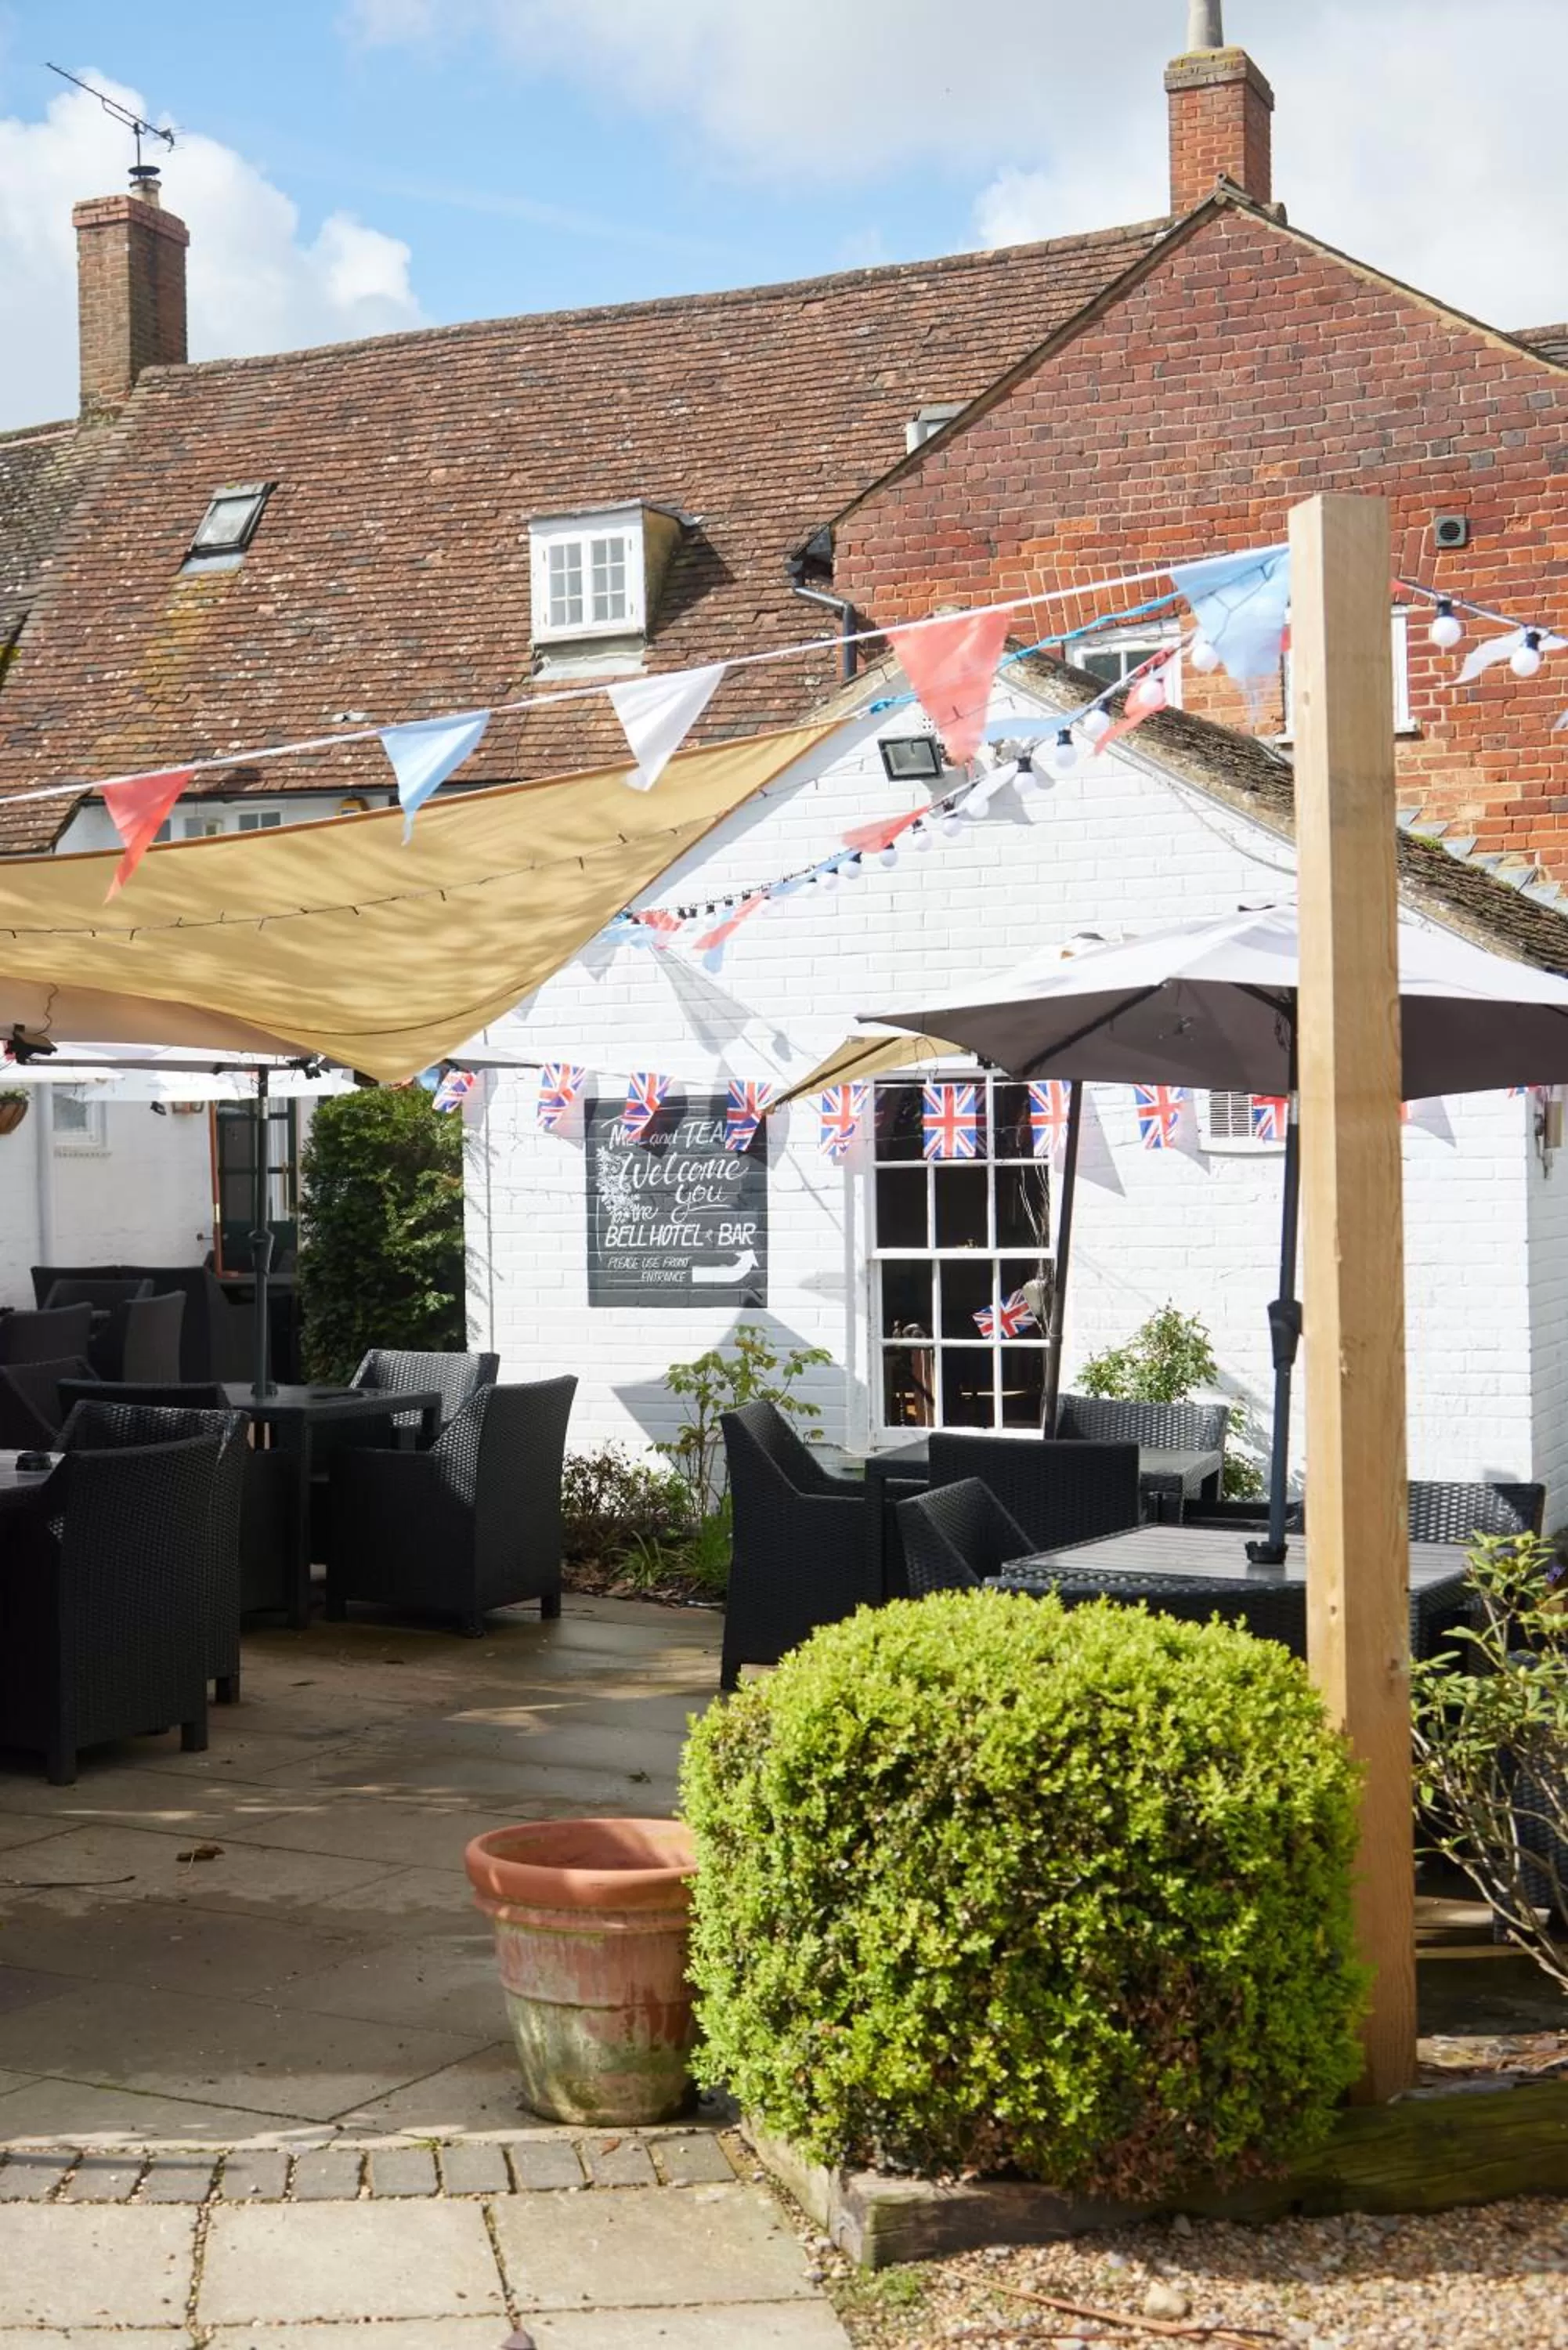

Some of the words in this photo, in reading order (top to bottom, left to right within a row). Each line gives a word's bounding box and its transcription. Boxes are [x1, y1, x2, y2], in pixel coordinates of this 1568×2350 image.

[650, 1129, 678, 1146] and
[683, 1121, 727, 1149] TEA
[620, 1152, 749, 1189] Welcome
[671, 1184, 732, 1224] you
[717, 1223, 757, 1246] BAR
